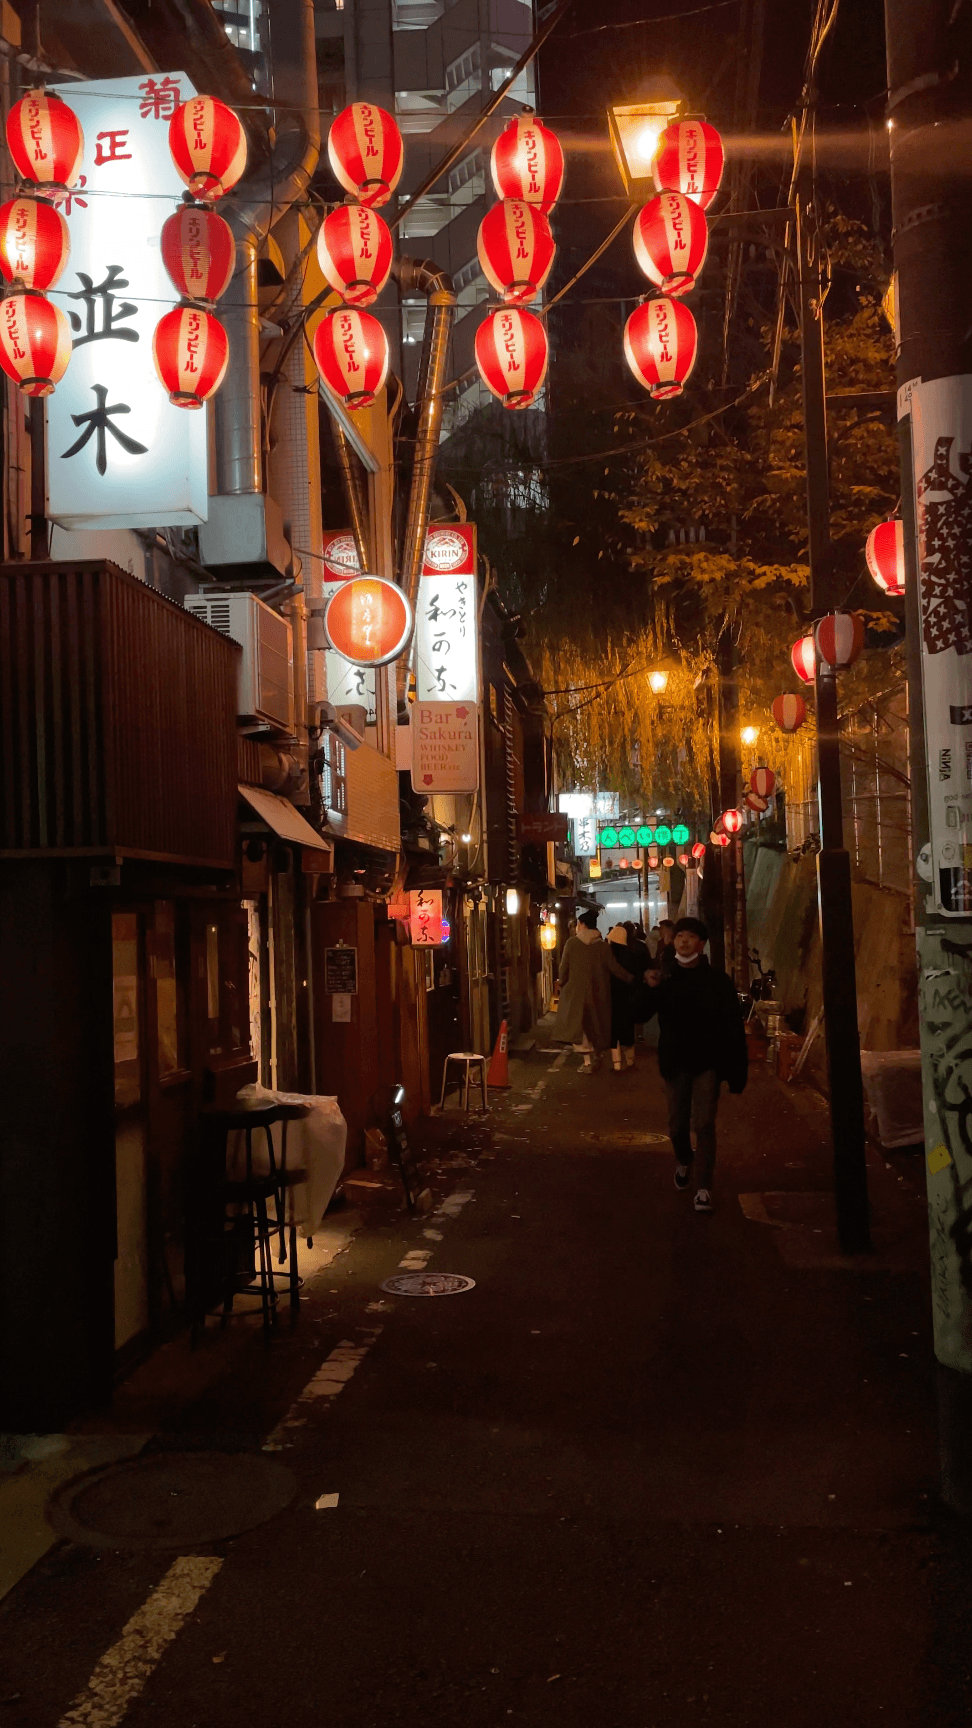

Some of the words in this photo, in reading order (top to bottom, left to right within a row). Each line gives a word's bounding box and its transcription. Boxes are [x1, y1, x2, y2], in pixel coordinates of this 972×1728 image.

[28, 99, 47, 161] キリンビール
[193, 101, 207, 150] キリンビール
[360, 105, 379, 157] キリンビール
[523, 130, 540, 194] キリンビール
[685, 129, 699, 193] キリンビール
[16, 208, 29, 271] キリンビール
[187, 217, 203, 280] キリンビール
[357, 206, 373, 259] キリンビール
[510, 201, 529, 259] キリンビール
[668, 195, 687, 251] キリンビール
[6, 300, 26, 359] キリンビール
[184, 313, 200, 373] キリンビール
[339, 315, 360, 373] キリンビール
[499, 314, 520, 372] キリンビール
[654, 304, 673, 362] キリンビール
[60, 264, 150, 478] 並木
[430, 549, 459, 559] KIRIN
[454, 580, 469, 638] やきとり
[419, 727, 473, 740] Sakura
[420, 709, 452, 724] Bar
[420, 744, 467, 752] WHISKEY
